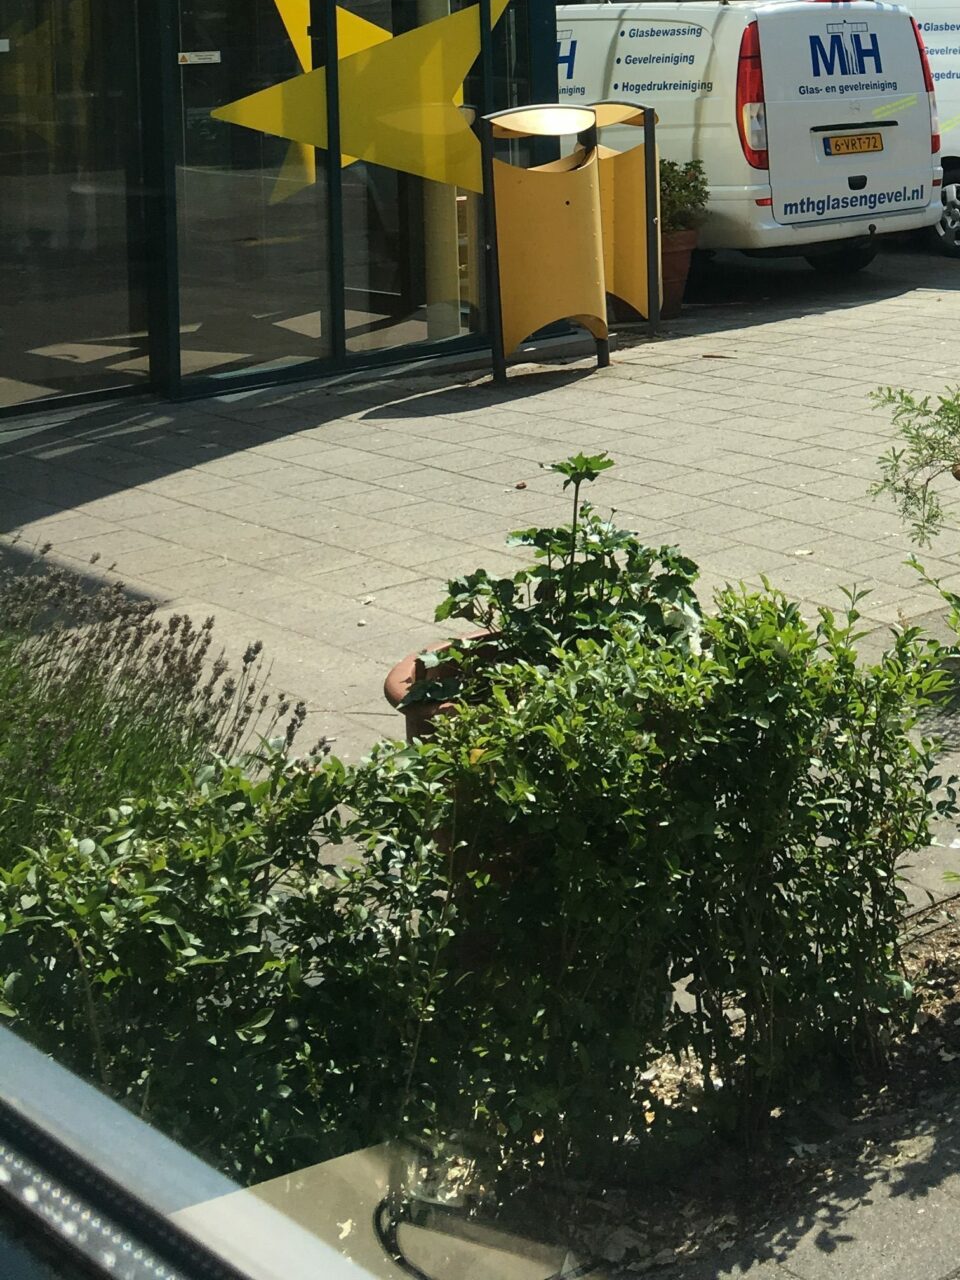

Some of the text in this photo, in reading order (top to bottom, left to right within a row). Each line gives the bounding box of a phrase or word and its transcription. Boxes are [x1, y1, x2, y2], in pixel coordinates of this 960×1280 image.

[628, 26, 703, 38] Glasbewassing
[556, 40, 577, 79] H
[624, 53, 695, 65] Gevelreiniging
[621, 80, 713, 94] Hogedrukreiniging
[798, 80, 898, 95] Glas- en gevelreiniging
[834, 136, 879, 151] 6-VRT-72
[783, 184, 924, 216] mthglasengevel.nl
